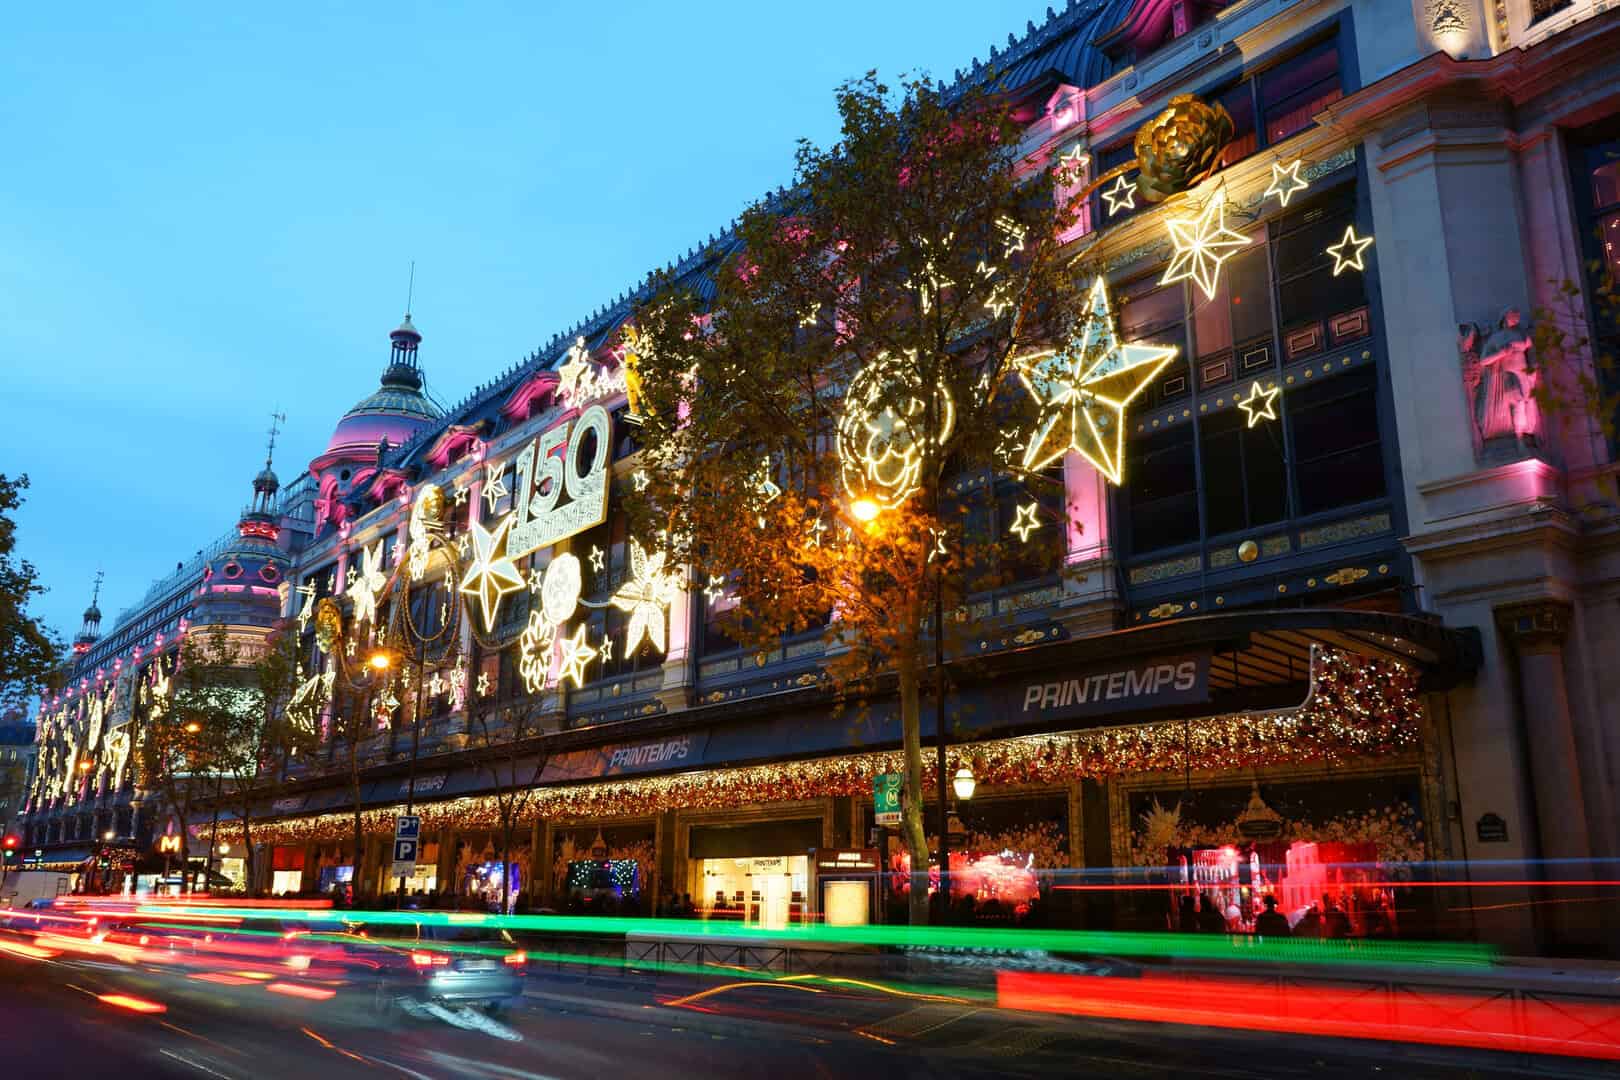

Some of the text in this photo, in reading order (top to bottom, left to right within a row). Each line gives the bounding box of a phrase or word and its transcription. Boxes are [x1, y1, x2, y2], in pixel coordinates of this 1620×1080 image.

[516, 404, 610, 530] 150
[1023, 661, 1196, 712] PRINTEMPS
[610, 741, 688, 767] PRINTEMPS
[398, 818, 410, 834] P
[160, 835, 181, 853] M
[400, 842, 412, 859] P
